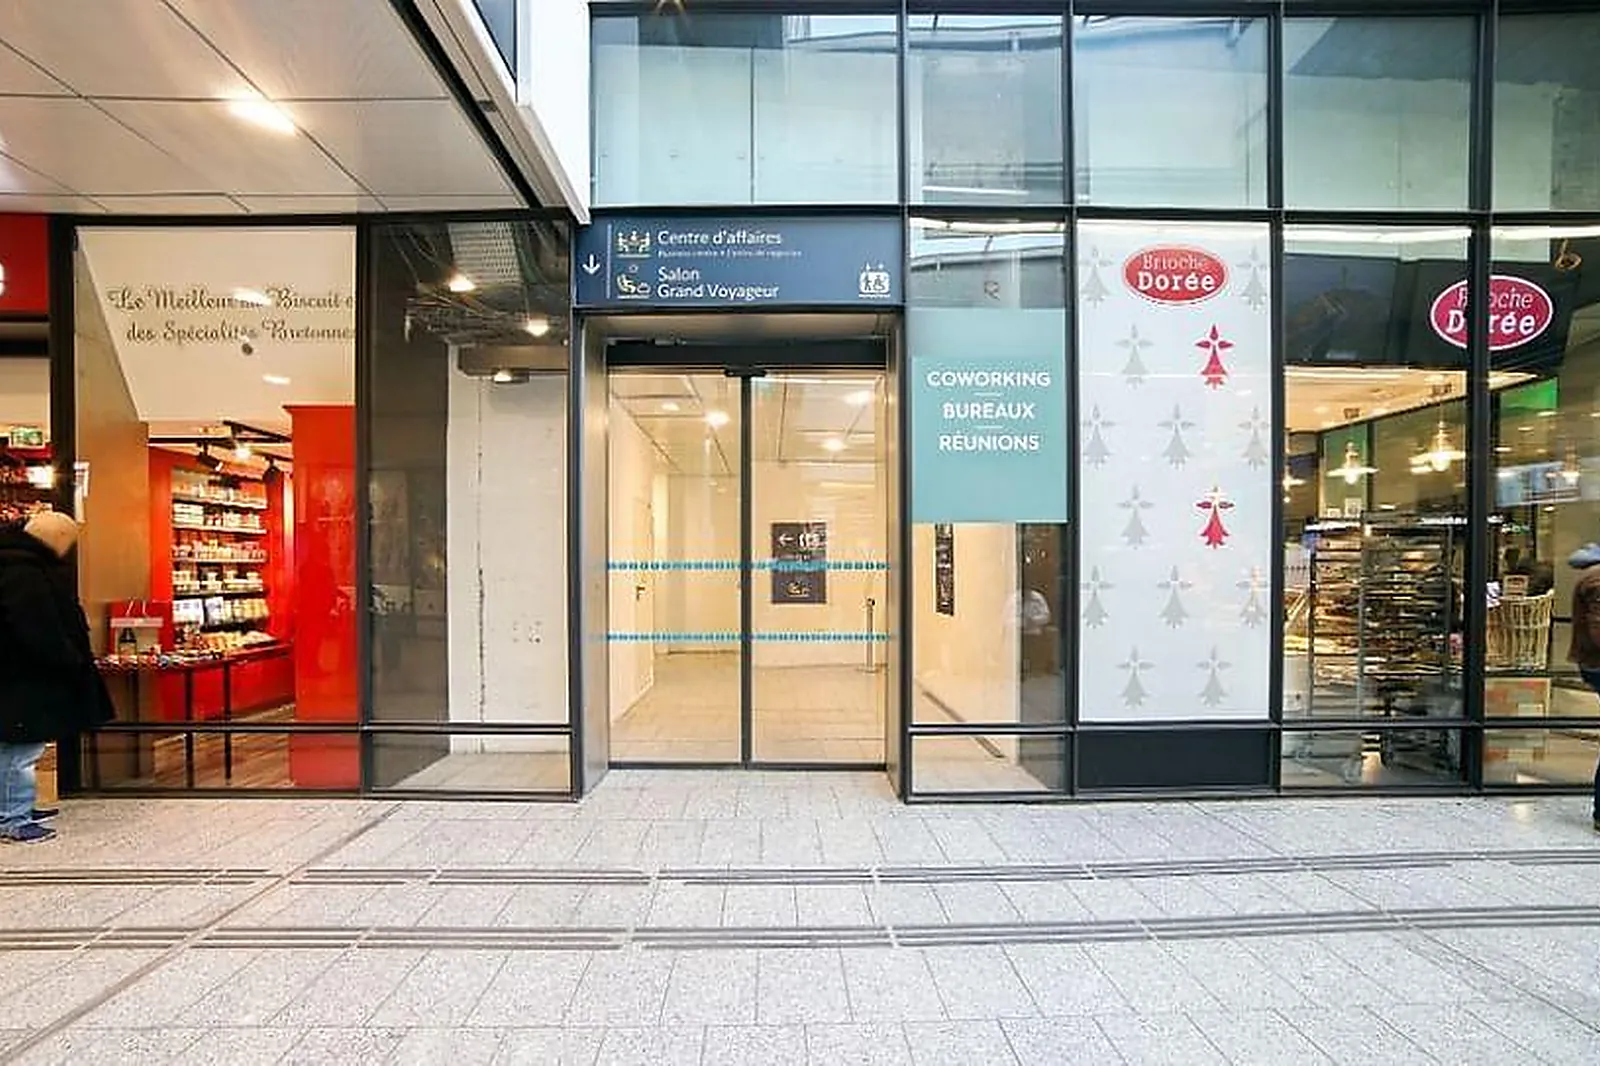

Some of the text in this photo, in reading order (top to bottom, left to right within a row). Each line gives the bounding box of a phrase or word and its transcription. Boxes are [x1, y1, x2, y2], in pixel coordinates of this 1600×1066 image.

[657, 230, 782, 245] Centre d'affaires
[658, 266, 700, 282] Salon
[1138, 271, 1216, 291] Dorée
[107, 288, 145, 311] Le
[265, 287, 340, 310] Biscuit
[657, 283, 779, 301] Grand Voyageur
[1456, 287, 1534, 309] Boche
[126, 321, 155, 341] des
[1447, 309, 1536, 335] Drée
[926, 371, 1051, 387] COWORKING
[943, 402, 1036, 420] BUREAUX
[939, 431, 1040, 451] RÉUNIONS
